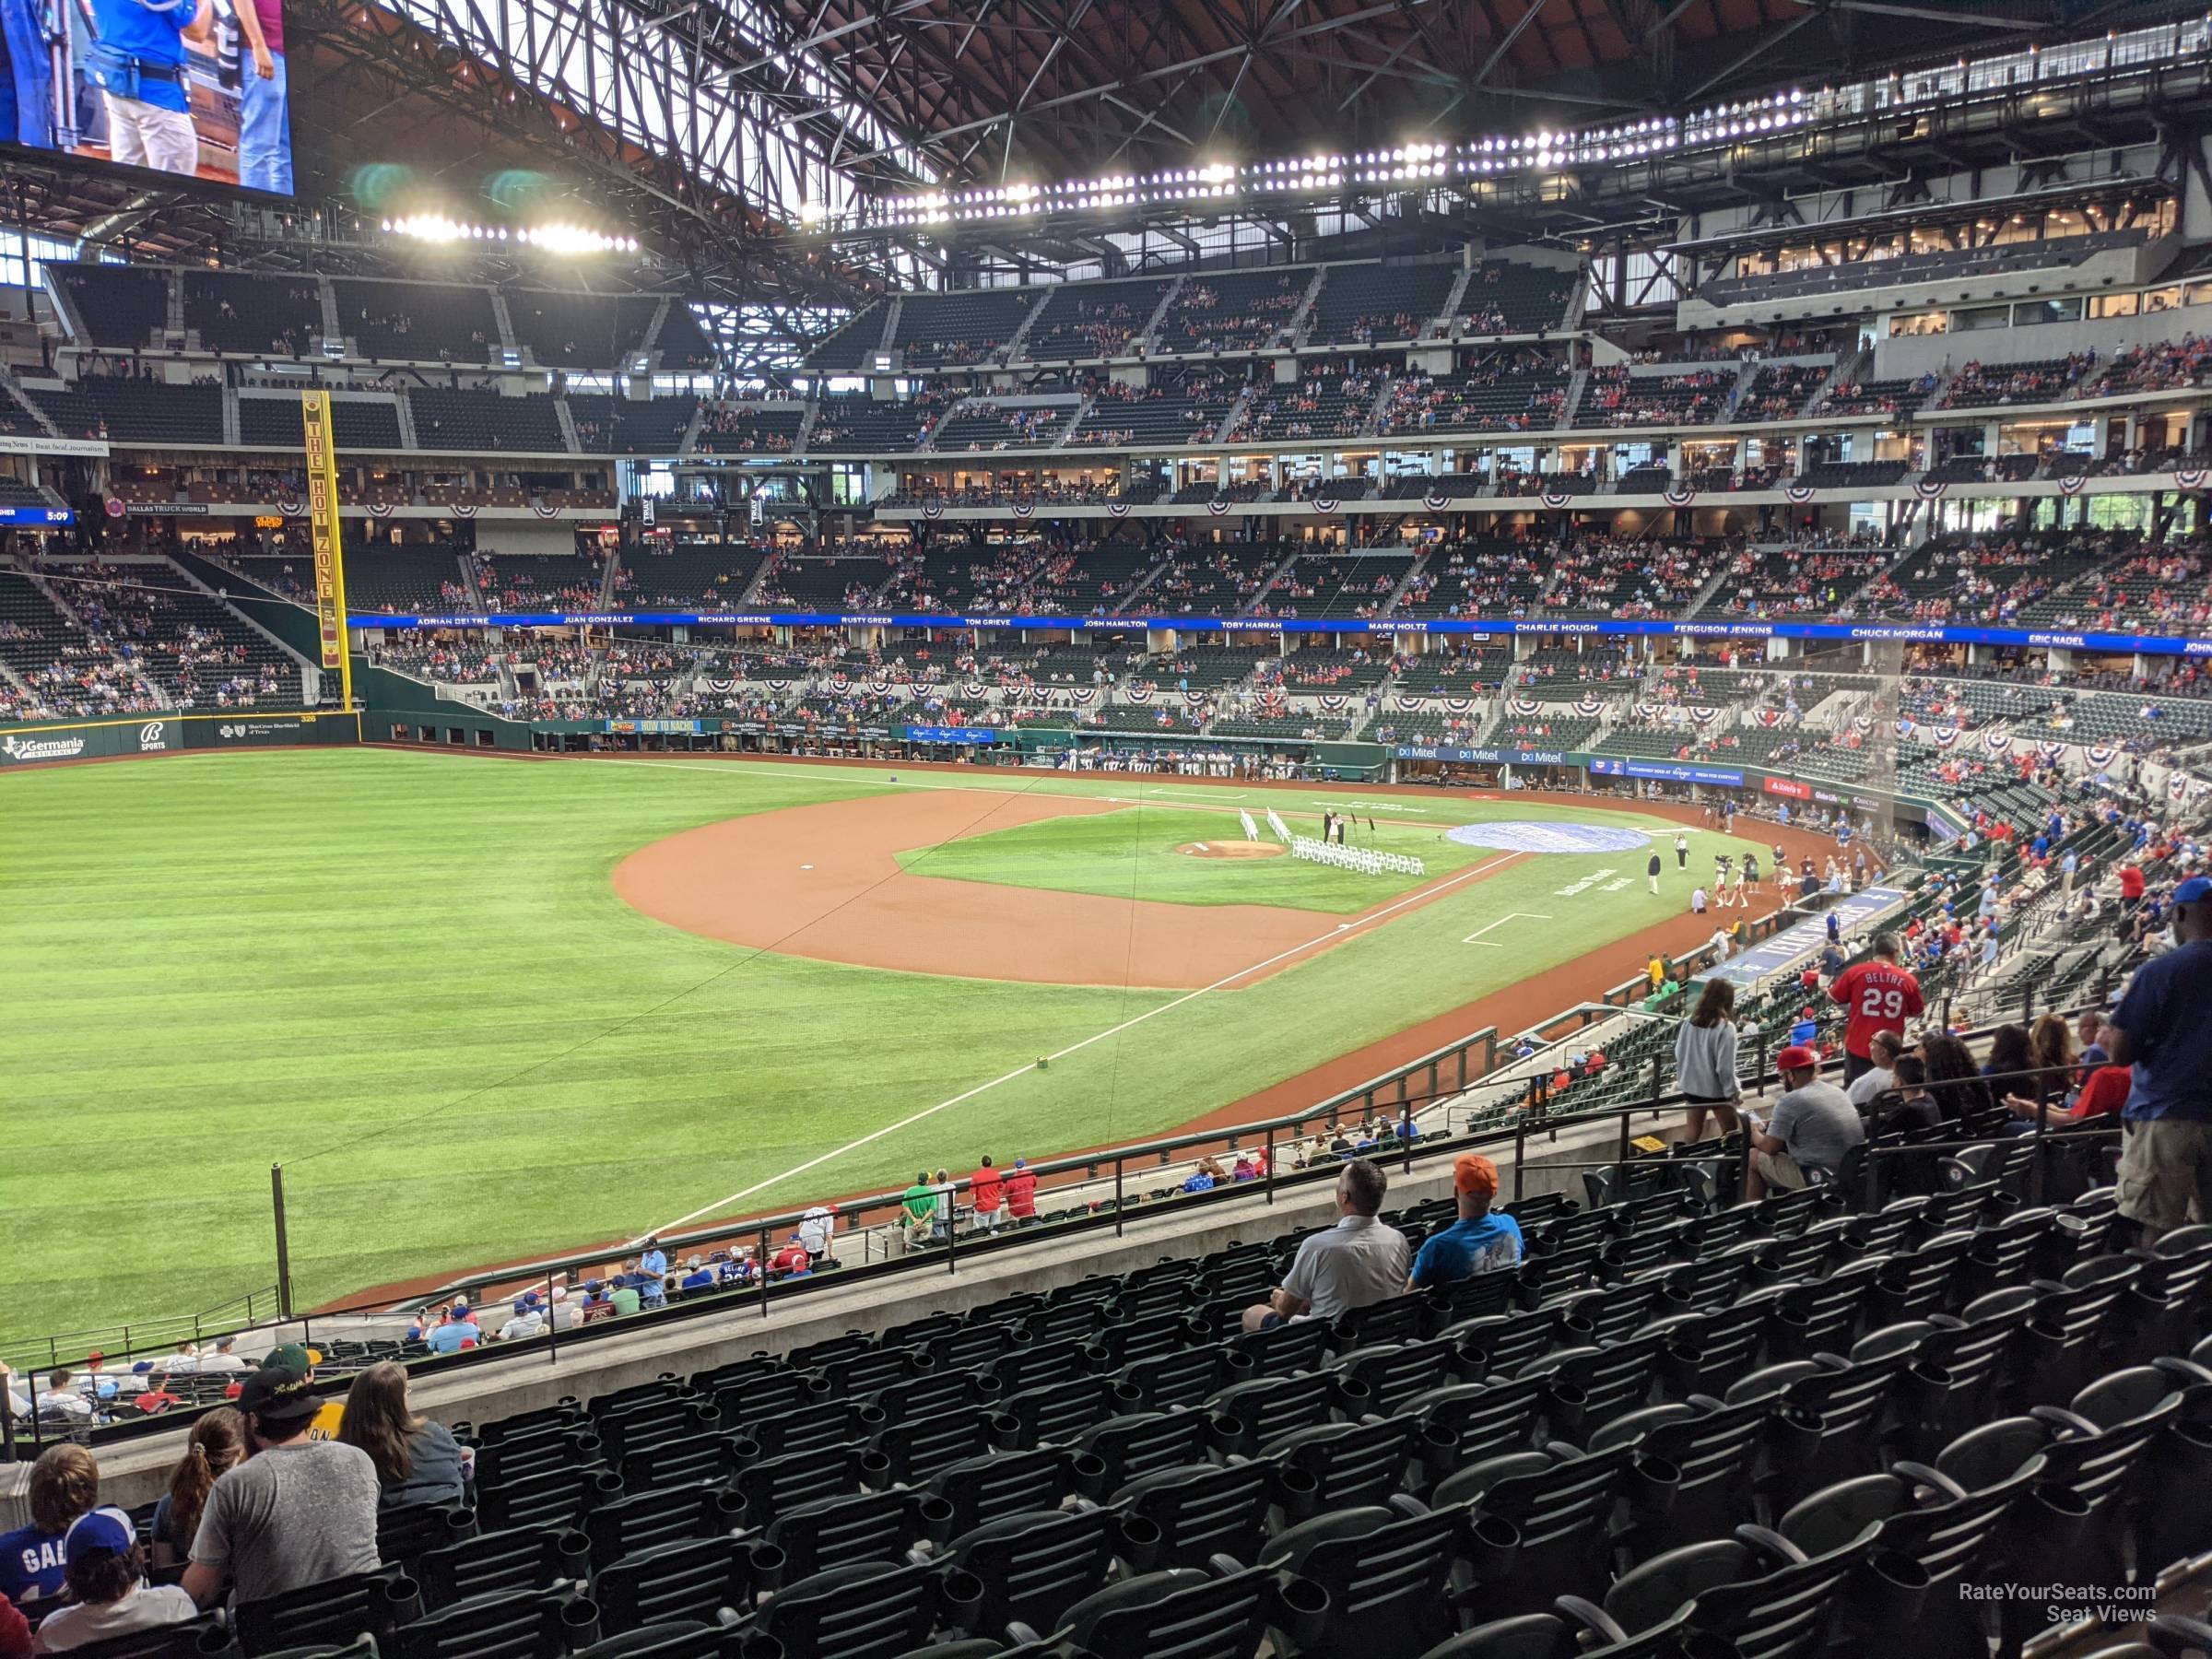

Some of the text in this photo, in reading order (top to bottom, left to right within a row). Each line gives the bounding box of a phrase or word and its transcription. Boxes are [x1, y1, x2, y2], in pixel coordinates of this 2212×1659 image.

[310, 423, 321, 467] THE
[313, 481, 325, 525] HOT
[47, 512, 68, 521] 5:09
[318, 538, 331, 597] ZONE
[1245, 621, 1282, 629] HARRAH
[1369, 622, 1394, 630] MARK
[1561, 624, 1598, 632] HOUGH
[1674, 625, 1772, 635] FERGUSON JENKINS
[1852, 629, 1944, 639] CHUCK MORGAN
[2029, 634, 2085, 646] ERIC NADEL
[641, 720, 658, 731] HOW
[661, 720, 669, 731] TO
[26, 737, 84, 751] Germania
[141, 741, 165, 751] SPORTS
[1412, 747, 1437, 759] Mitel
[1472, 749, 1500, 760] Mitel
[1535, 752, 1562, 763] Mitel
[1756, 932, 1824, 956] TEXAS
[1865, 972, 1904, 987] BELTRE
[1863, 988, 1902, 1018] 29
[22, 1539, 66, 1573] GAL
